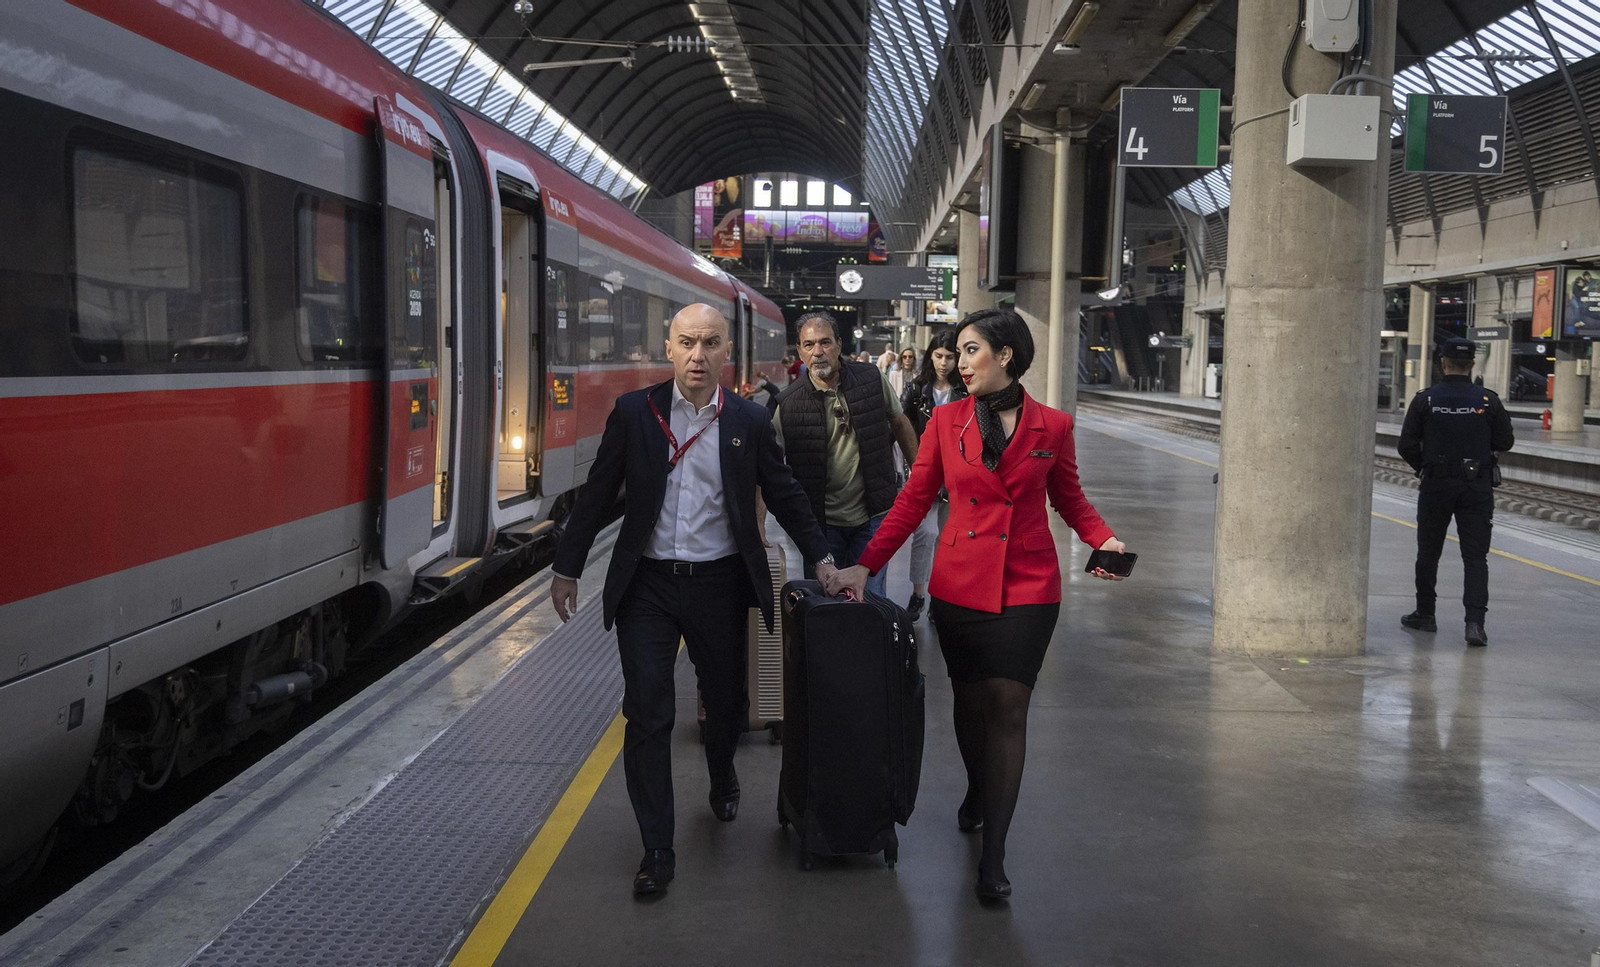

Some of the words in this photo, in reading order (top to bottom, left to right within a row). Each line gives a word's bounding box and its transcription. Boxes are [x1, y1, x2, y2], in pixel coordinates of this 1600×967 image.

[1172, 94, 1187, 104] Vía
[1433, 100, 1448, 110] Vía
[1125, 127, 1149, 161] 4
[1478, 135, 1498, 169] 5
[834, 223, 862, 233] Fresa
[1432, 406, 1477, 414] POLICIA
